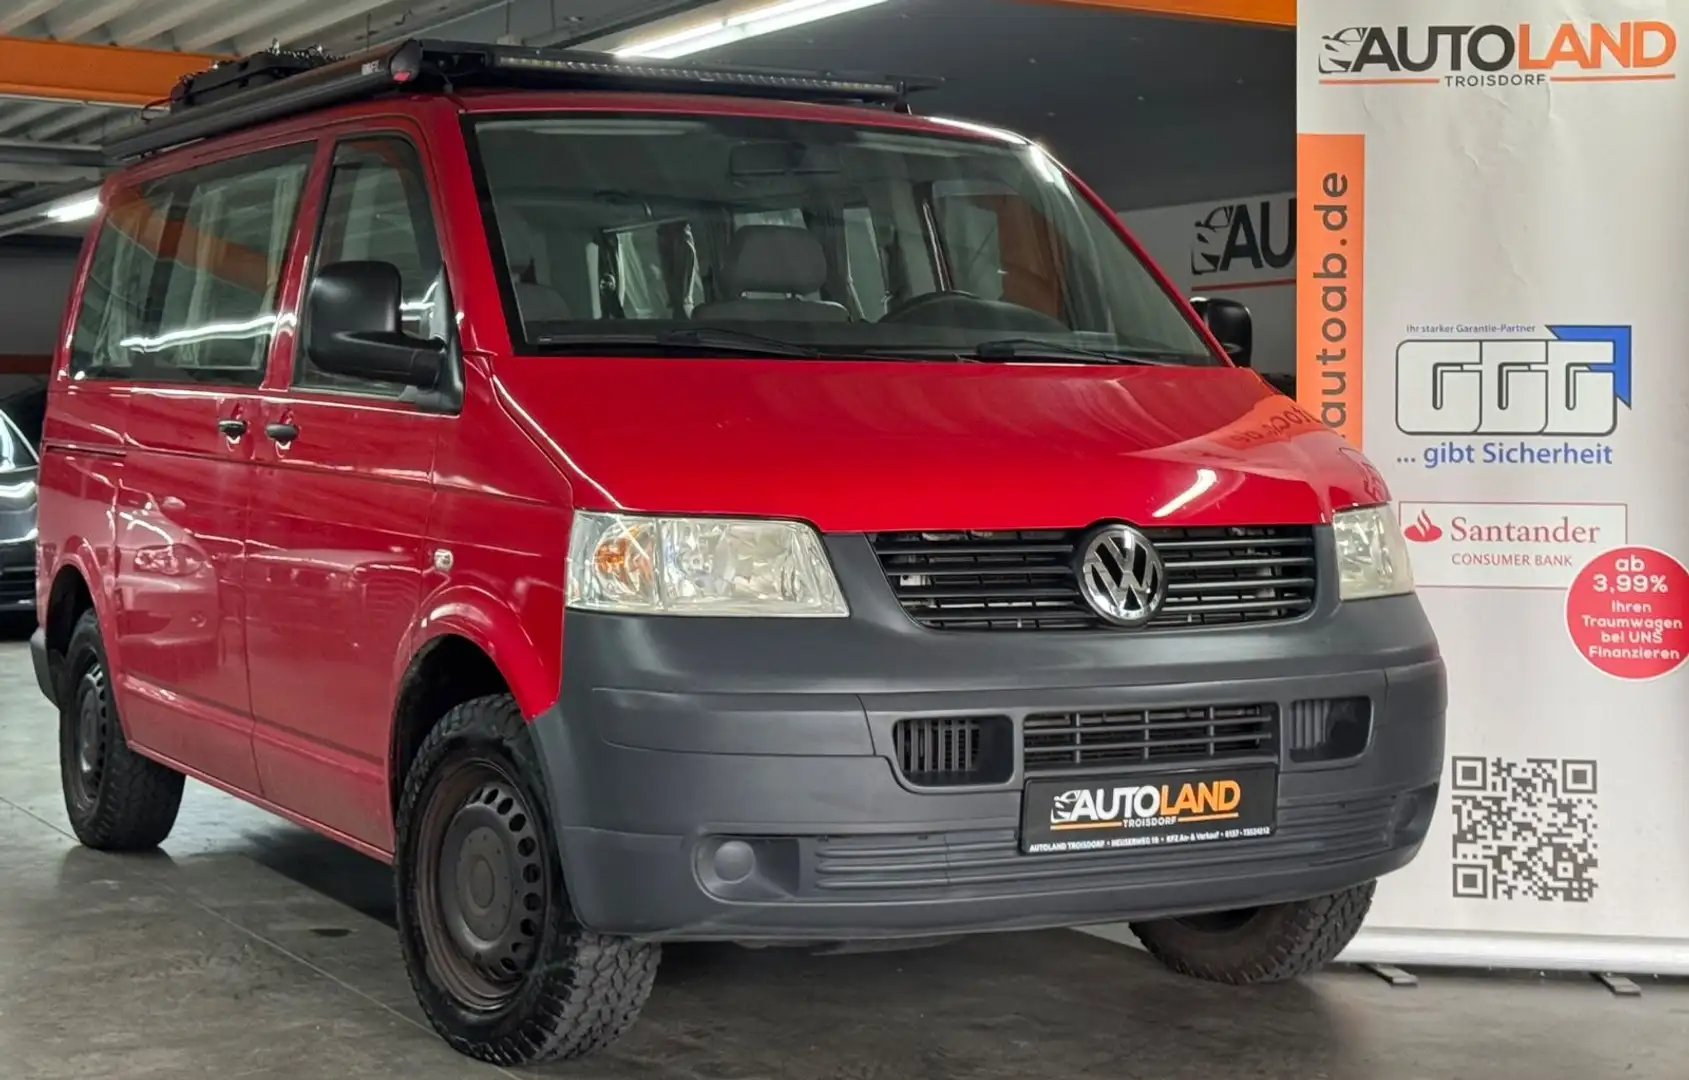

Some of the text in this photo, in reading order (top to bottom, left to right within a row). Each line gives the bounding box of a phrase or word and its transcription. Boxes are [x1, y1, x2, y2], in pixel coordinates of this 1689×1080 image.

[1351, 21, 1677, 72] AUTOLAND
[1444, 74, 1547, 87] TROISDORF
[1406, 324, 1536, 333] Ihr starker Garantie-Partner
[1423, 442, 1475, 468] gibt
[1482, 442, 1613, 464] Sicherheit
[1450, 516, 1601, 543] Santander
[1451, 554, 1573, 568] CONSUMER BANK
[1615, 555, 1645, 572] ab
[1592, 574, 1668, 594] 3,99%
[1611, 600, 1652, 613] Ihren
[1582, 615, 1683, 633] Traumwagen
[1601, 630, 1664, 644] bei UNS
[1589, 645, 1680, 660] Finanzieren
[1069, 780, 1241, 821] AUTOLAND
[1122, 816, 1177, 828] TROISDORF
[1029, 842, 1067, 852] AUTOLAND
[1068, 840, 1105, 850] TROISDORF
[1196, 831, 1219, 840] Verkauf
